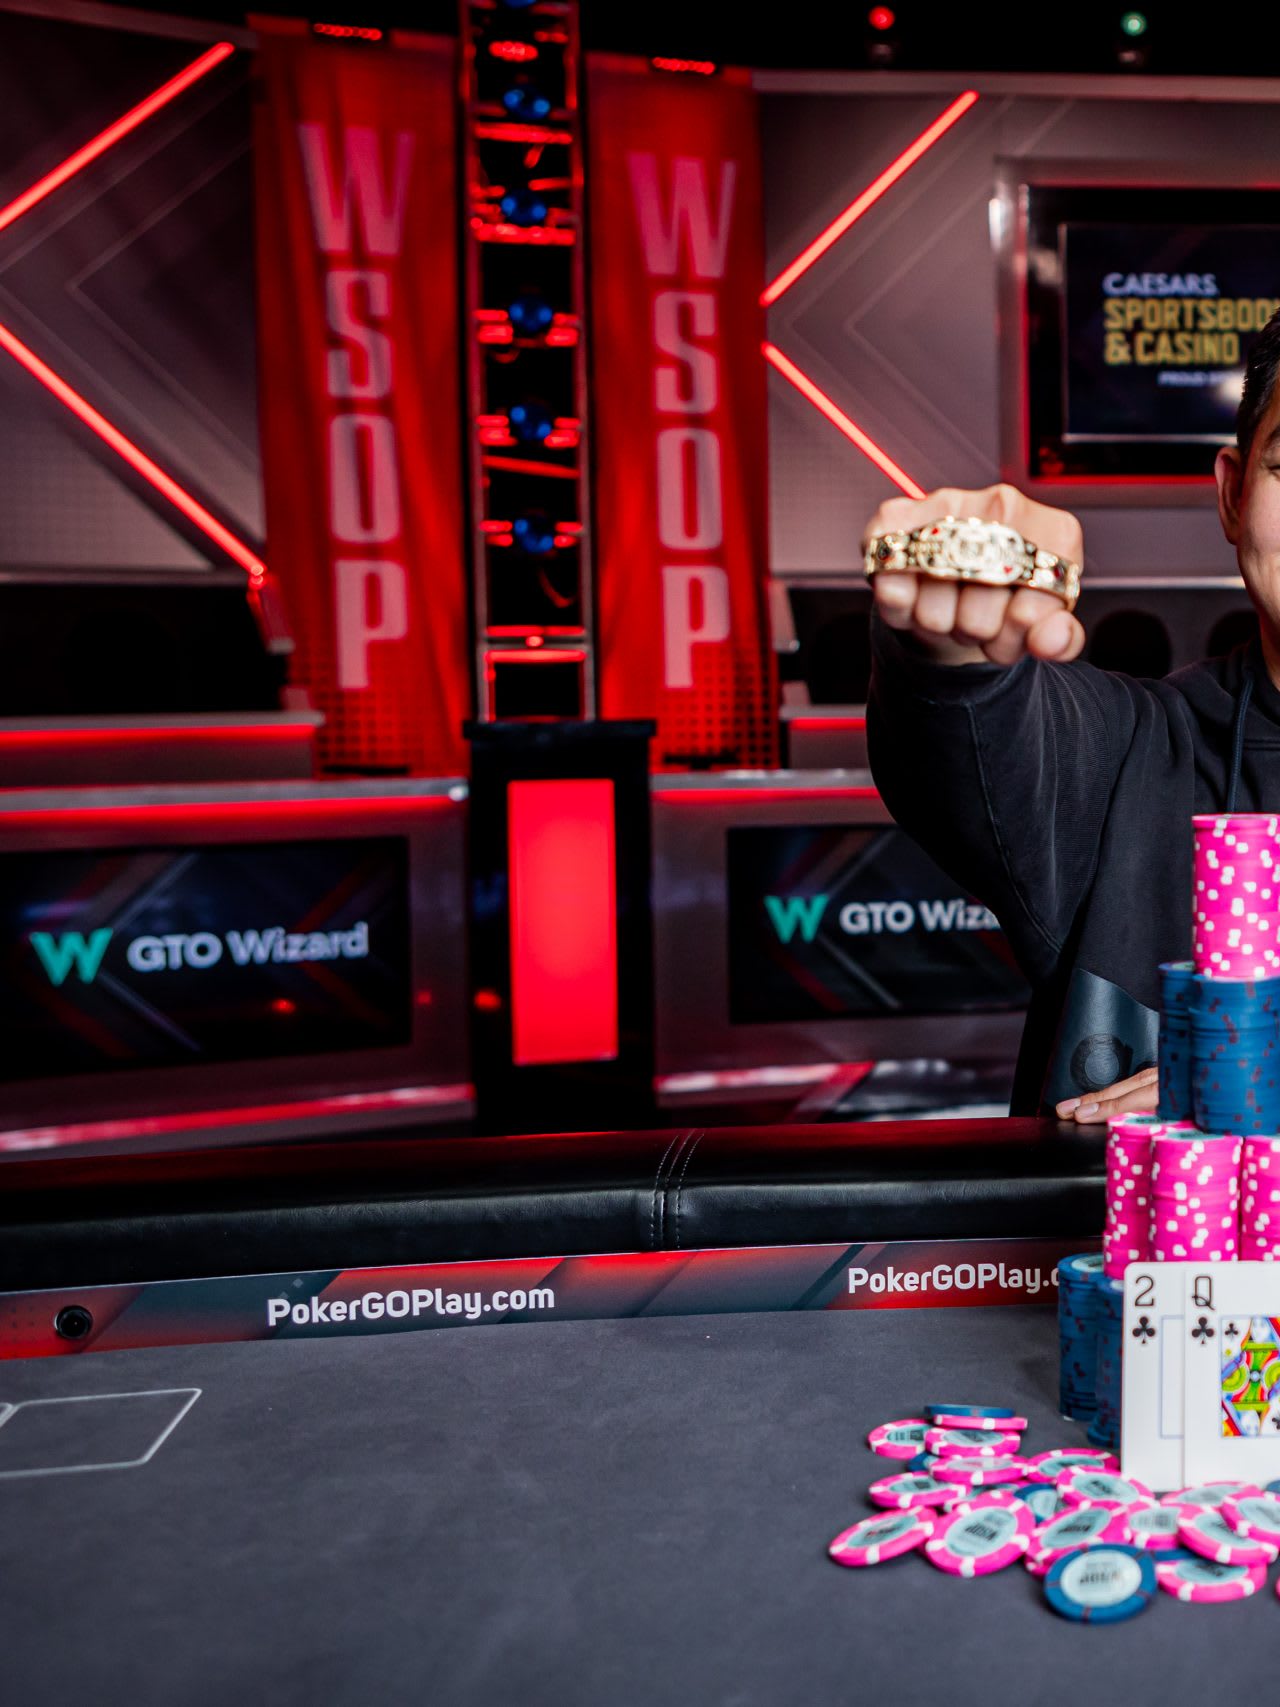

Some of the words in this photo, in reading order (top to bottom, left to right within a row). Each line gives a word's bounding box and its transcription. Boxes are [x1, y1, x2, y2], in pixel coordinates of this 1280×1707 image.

[1102, 273, 1217, 296] CAESARS
[1104, 333, 1131, 365] &
[1134, 333, 1239, 365] CASINO
[300, 124, 414, 689] WSOP
[626, 152, 738, 689] WSOP
[839, 902, 914, 933] GTO
[126, 932, 223, 972] GTO
[226, 922, 369, 965] Wizard
[267, 1288, 555, 1326] PokerGOPlay.com
[1134, 1275, 1154, 1307] 2
[1191, 1276, 1215, 1310] Q
